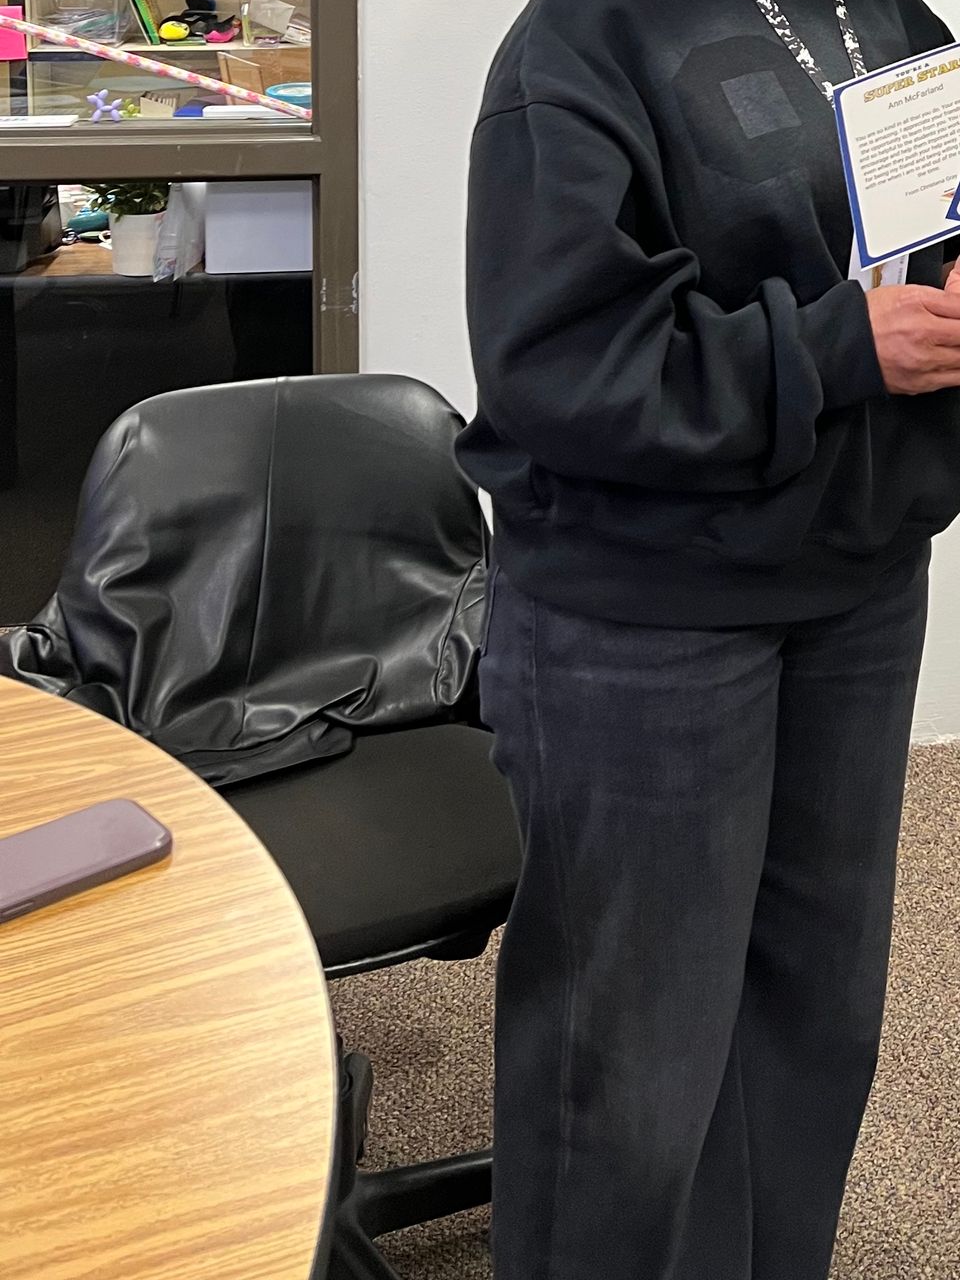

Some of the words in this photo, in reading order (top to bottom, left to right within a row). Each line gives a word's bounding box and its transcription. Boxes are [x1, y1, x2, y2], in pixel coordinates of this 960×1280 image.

[864, 77, 914, 102] SUPER
[888, 100, 903, 109] Ann
[905, 84, 943, 103] McFarland
